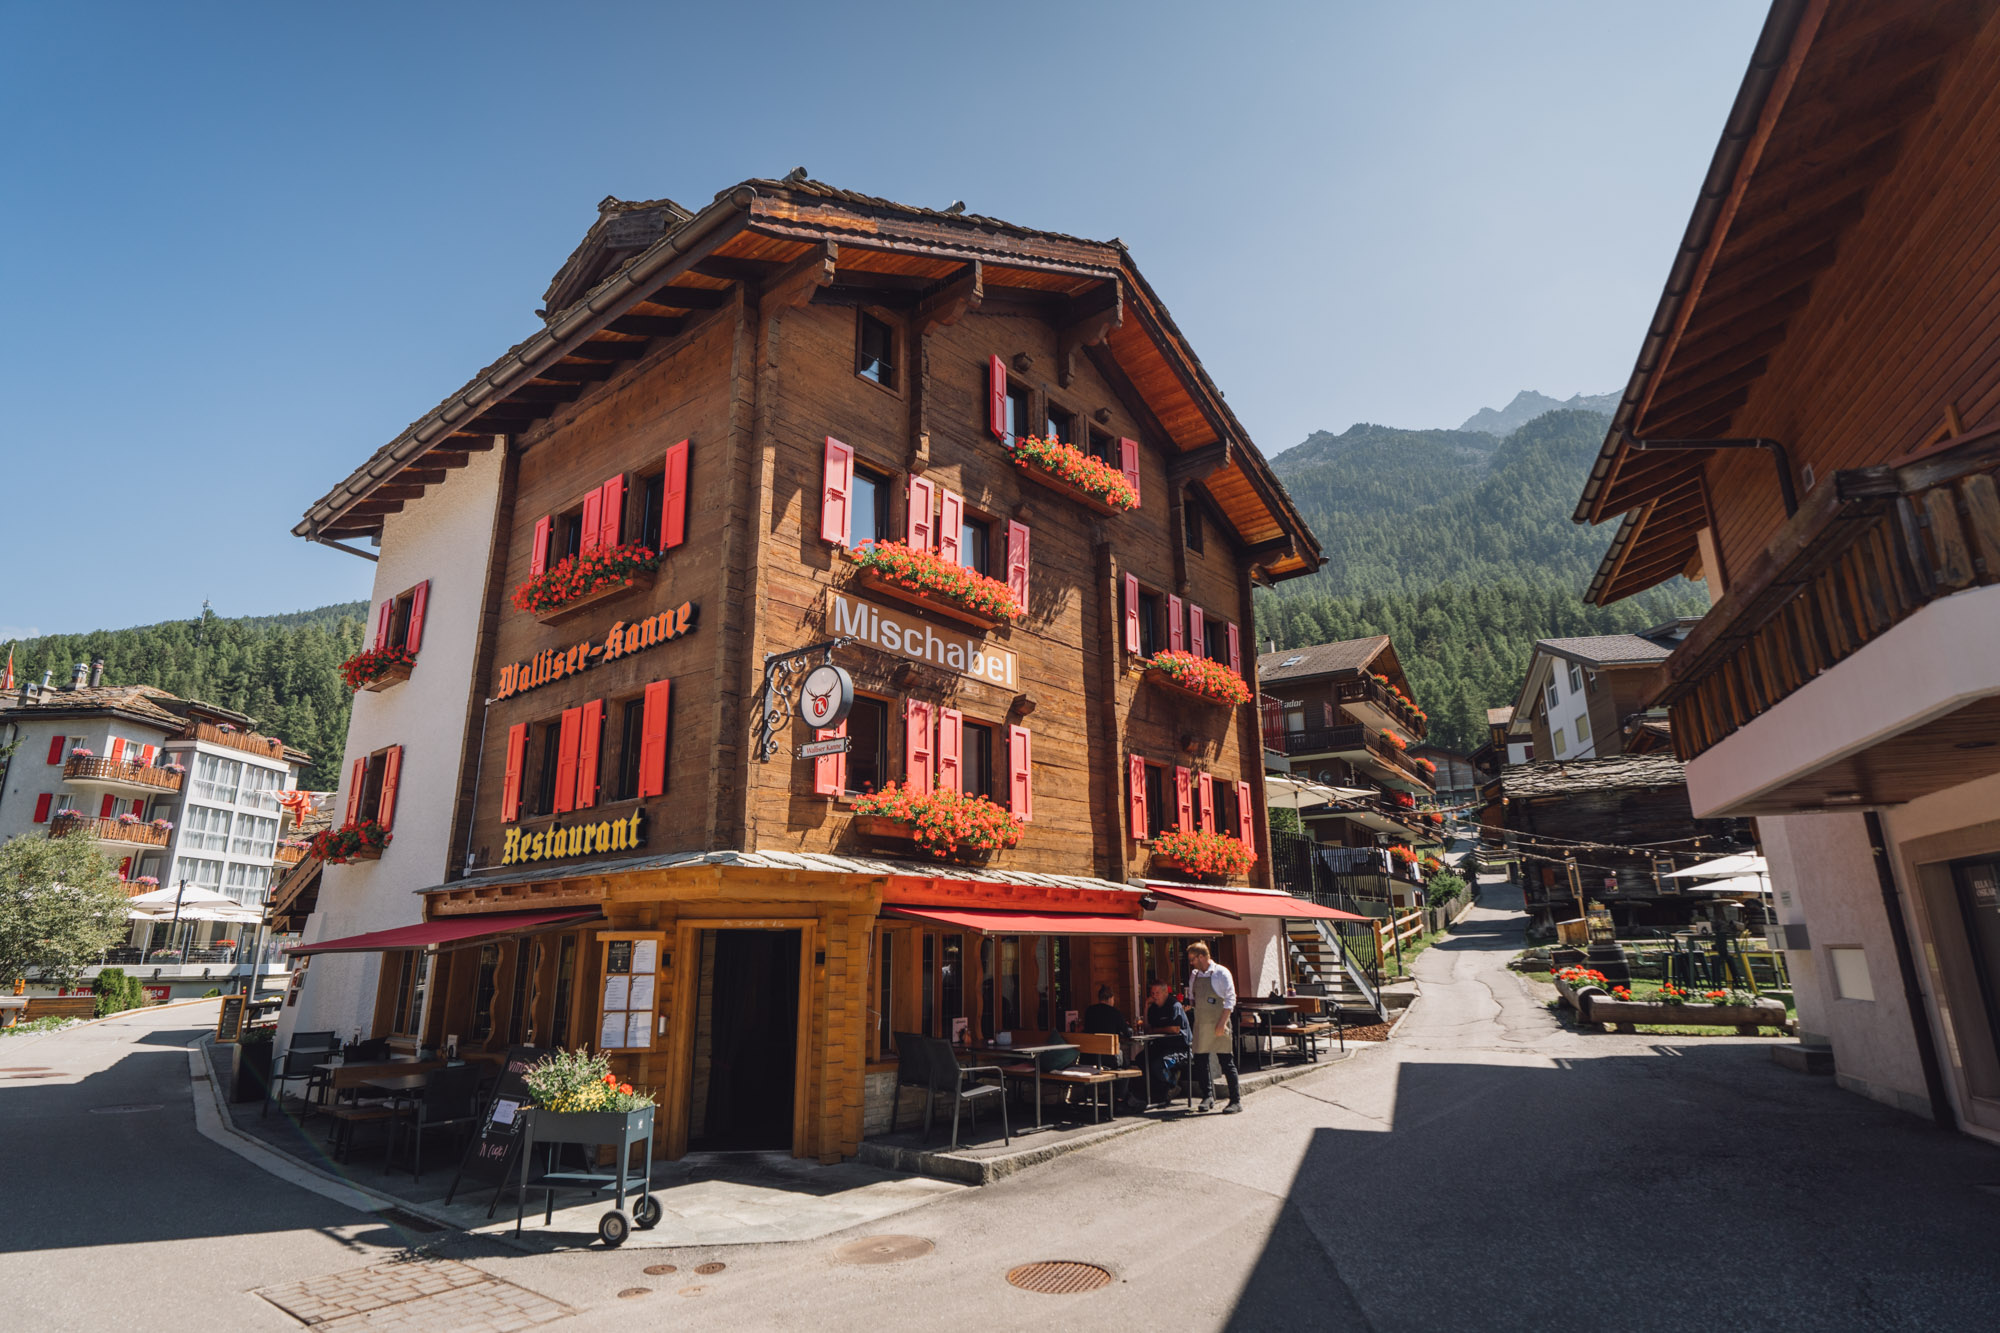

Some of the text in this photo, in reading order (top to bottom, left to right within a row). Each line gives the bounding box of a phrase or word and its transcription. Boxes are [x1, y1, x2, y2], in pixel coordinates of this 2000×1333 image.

[497, 600, 692, 700] Walliser-Kanne
[834, 596, 1013, 685] Mischabel
[806, 744, 841, 754] Walliser Kanne
[501, 808, 643, 866] Restaurant
